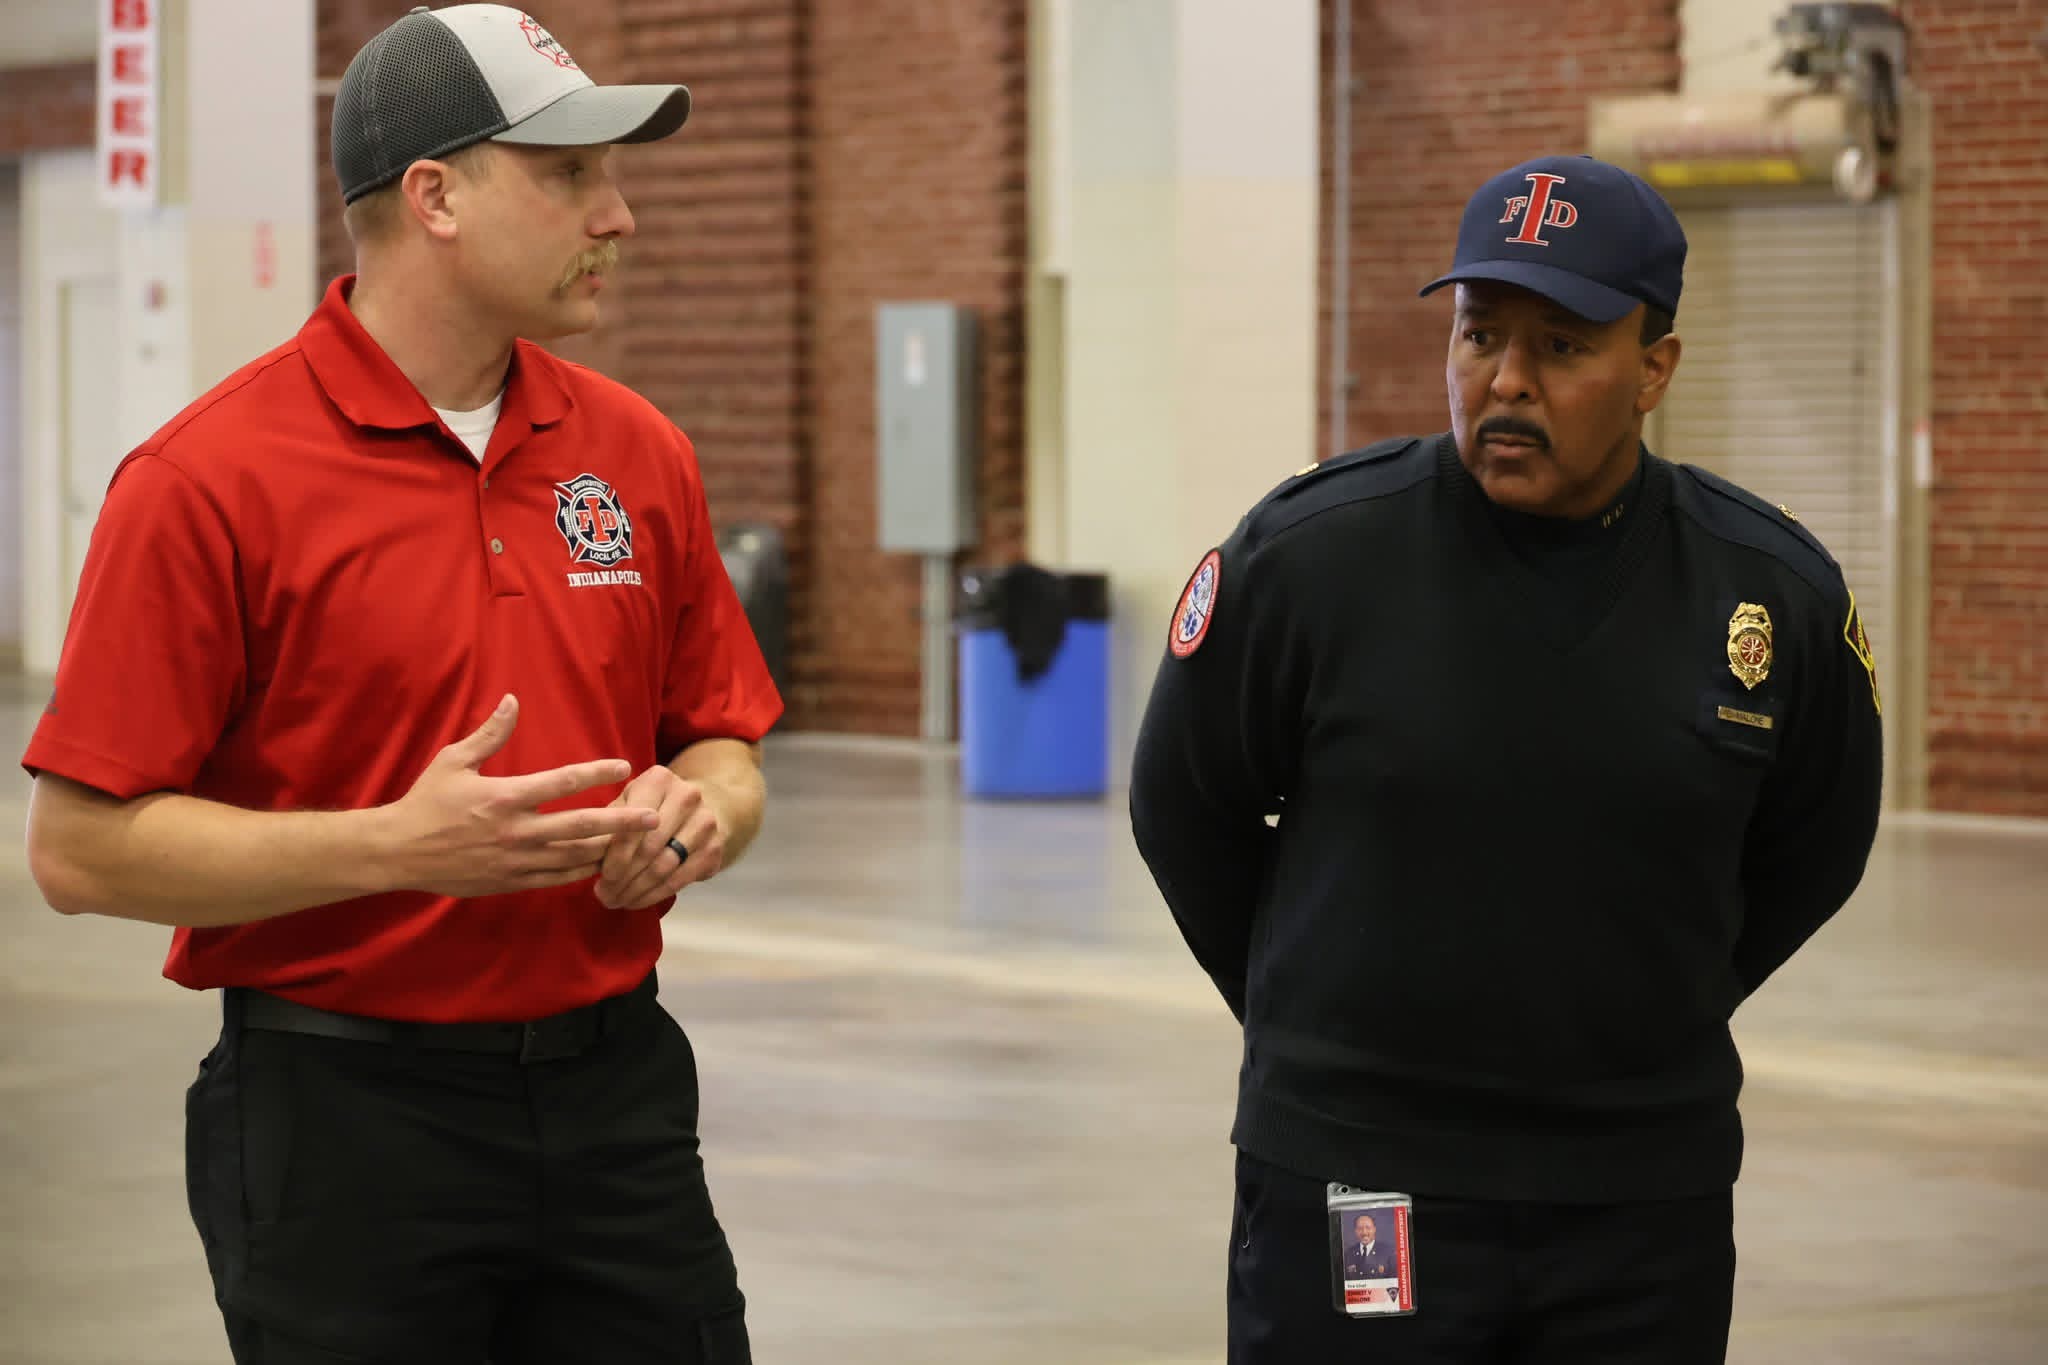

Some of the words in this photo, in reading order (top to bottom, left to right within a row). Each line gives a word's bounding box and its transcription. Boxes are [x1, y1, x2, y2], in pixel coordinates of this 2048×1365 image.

[108, 0, 150, 188] BEER
[589, 550, 611, 561] LOCAL
[567, 570, 642, 587] INDIANAPOLIS
